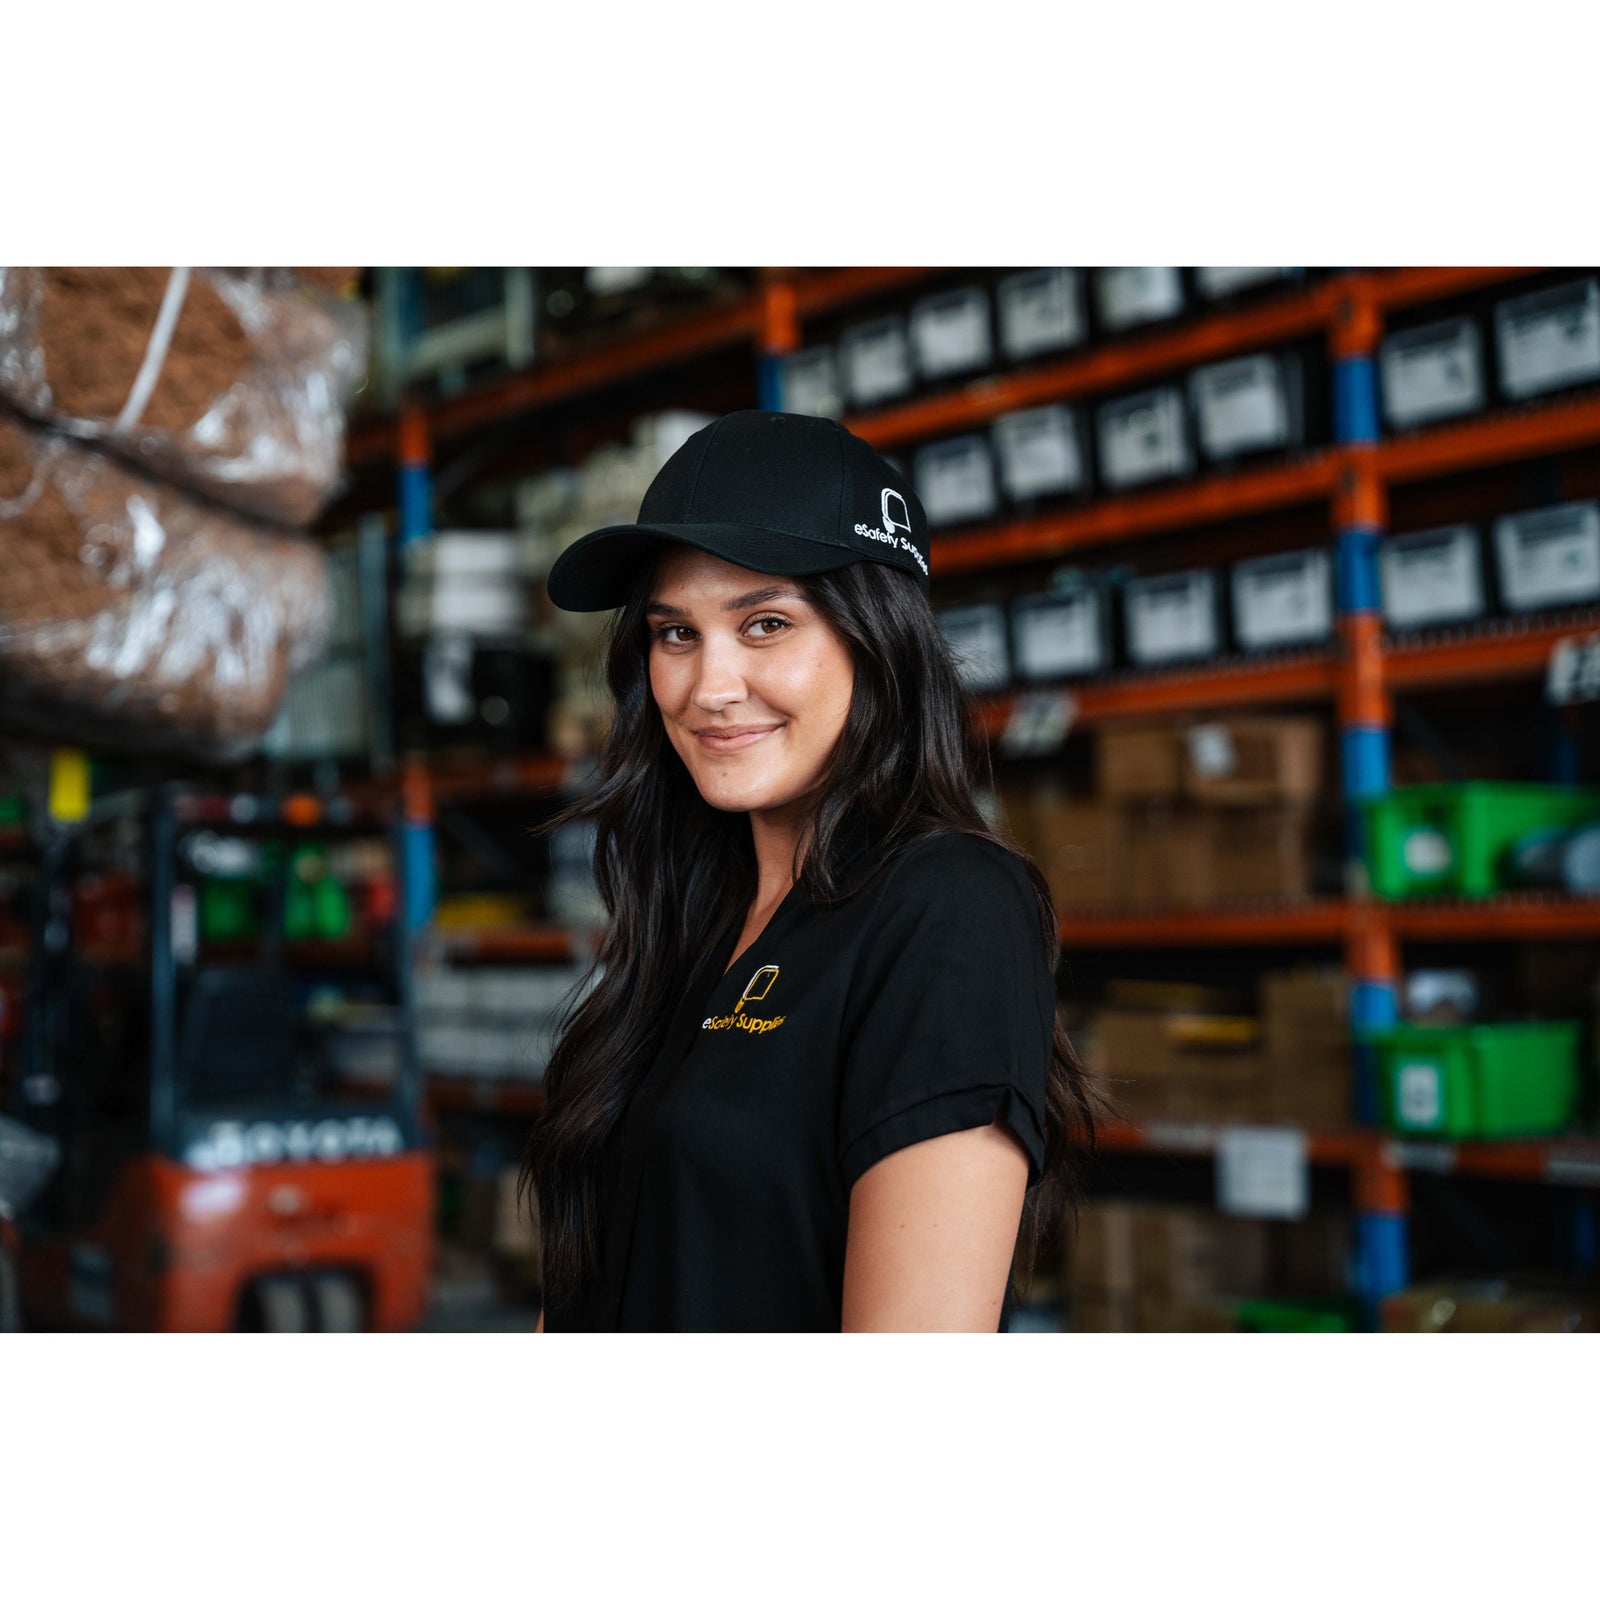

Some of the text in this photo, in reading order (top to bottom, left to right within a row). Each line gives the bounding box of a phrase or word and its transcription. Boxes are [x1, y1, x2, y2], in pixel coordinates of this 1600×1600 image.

[854, 523, 898, 549] eSafety
[736, 1013, 787, 1034] Supplie
[206, 1117, 403, 1166] TOYOTA
